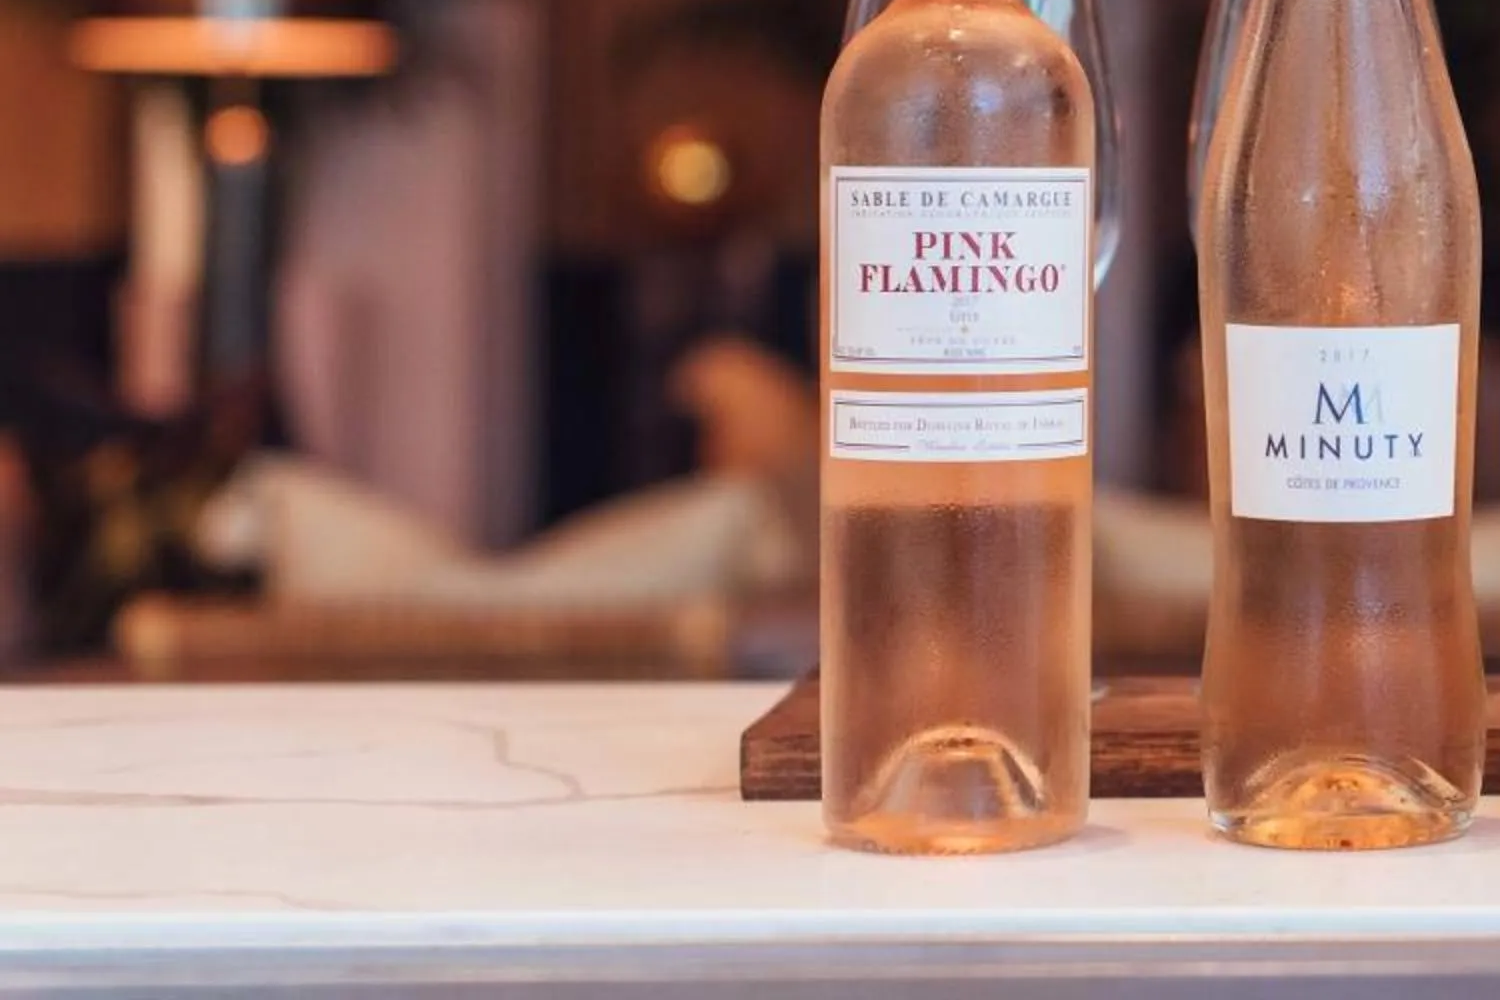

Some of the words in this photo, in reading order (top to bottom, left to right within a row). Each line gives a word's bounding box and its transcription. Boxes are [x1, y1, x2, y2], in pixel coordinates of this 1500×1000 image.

[850, 190, 911, 208] SABLE
[920, 191, 950, 208] DE
[960, 190, 1072, 208] CAMARGUE
[911, 231, 1018, 261] PINK
[859, 263, 1060, 294] FLAMINGO
[1319, 348, 1370, 363] 2017
[1264, 431, 1424, 461] MINUTY
[1325, 476, 1338, 490] DE
[1343, 476, 1401, 490] PROVENCE
